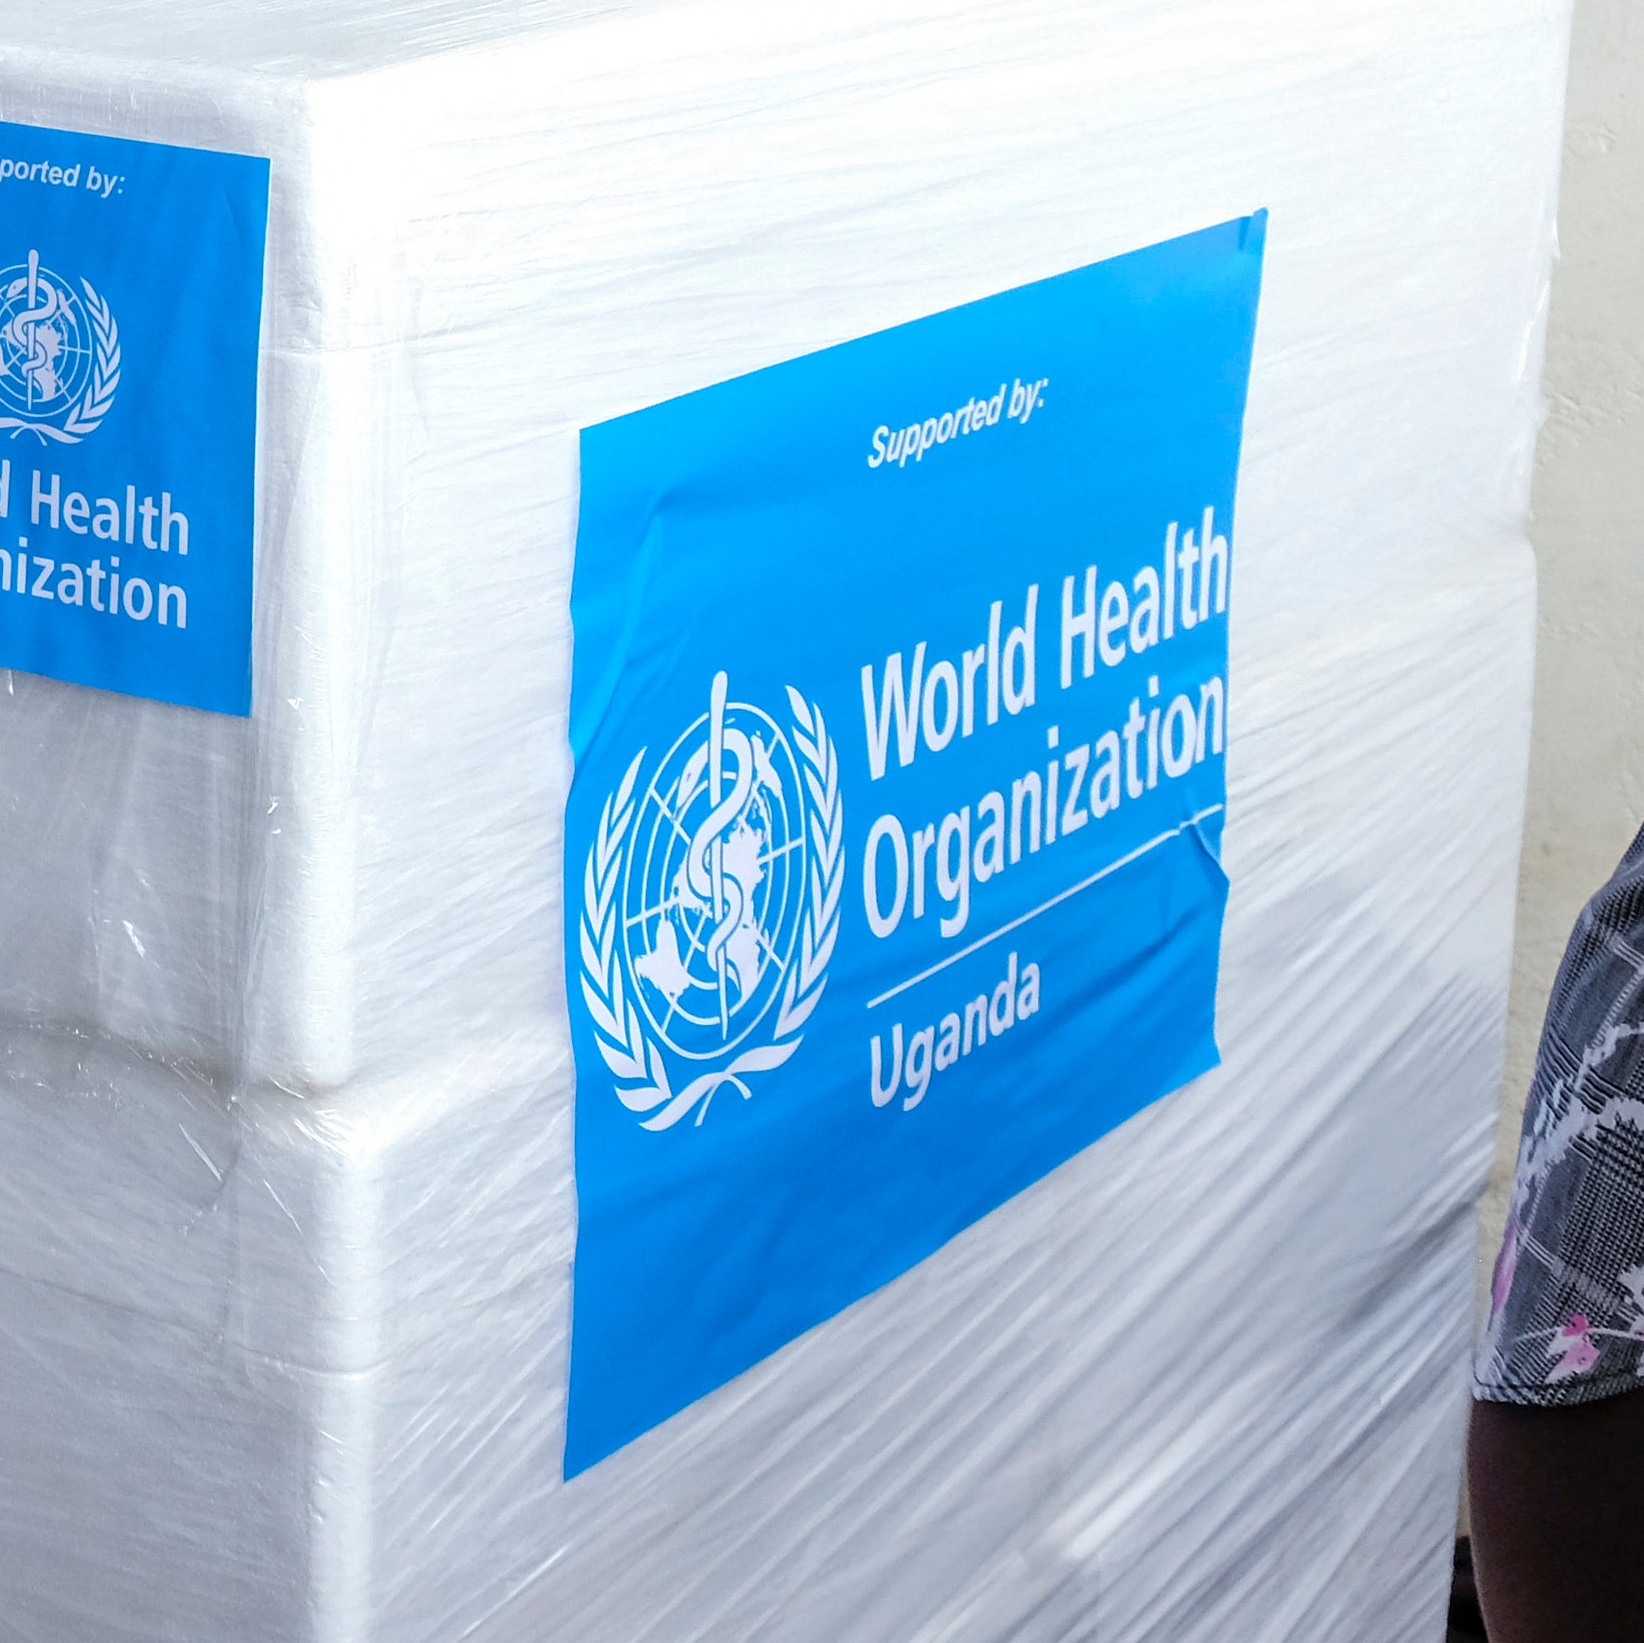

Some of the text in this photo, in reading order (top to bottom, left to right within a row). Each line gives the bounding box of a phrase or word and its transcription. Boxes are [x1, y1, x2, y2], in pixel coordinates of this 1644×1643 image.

[86, 168, 125, 199] by:
[868, 377, 1049, 469] Supported by:
[31, 470, 189, 555] Health
[862, 504, 1227, 781] World Health
[865, 672, 1225, 941] Organization
[868, 953, 1040, 1112] Uganda
